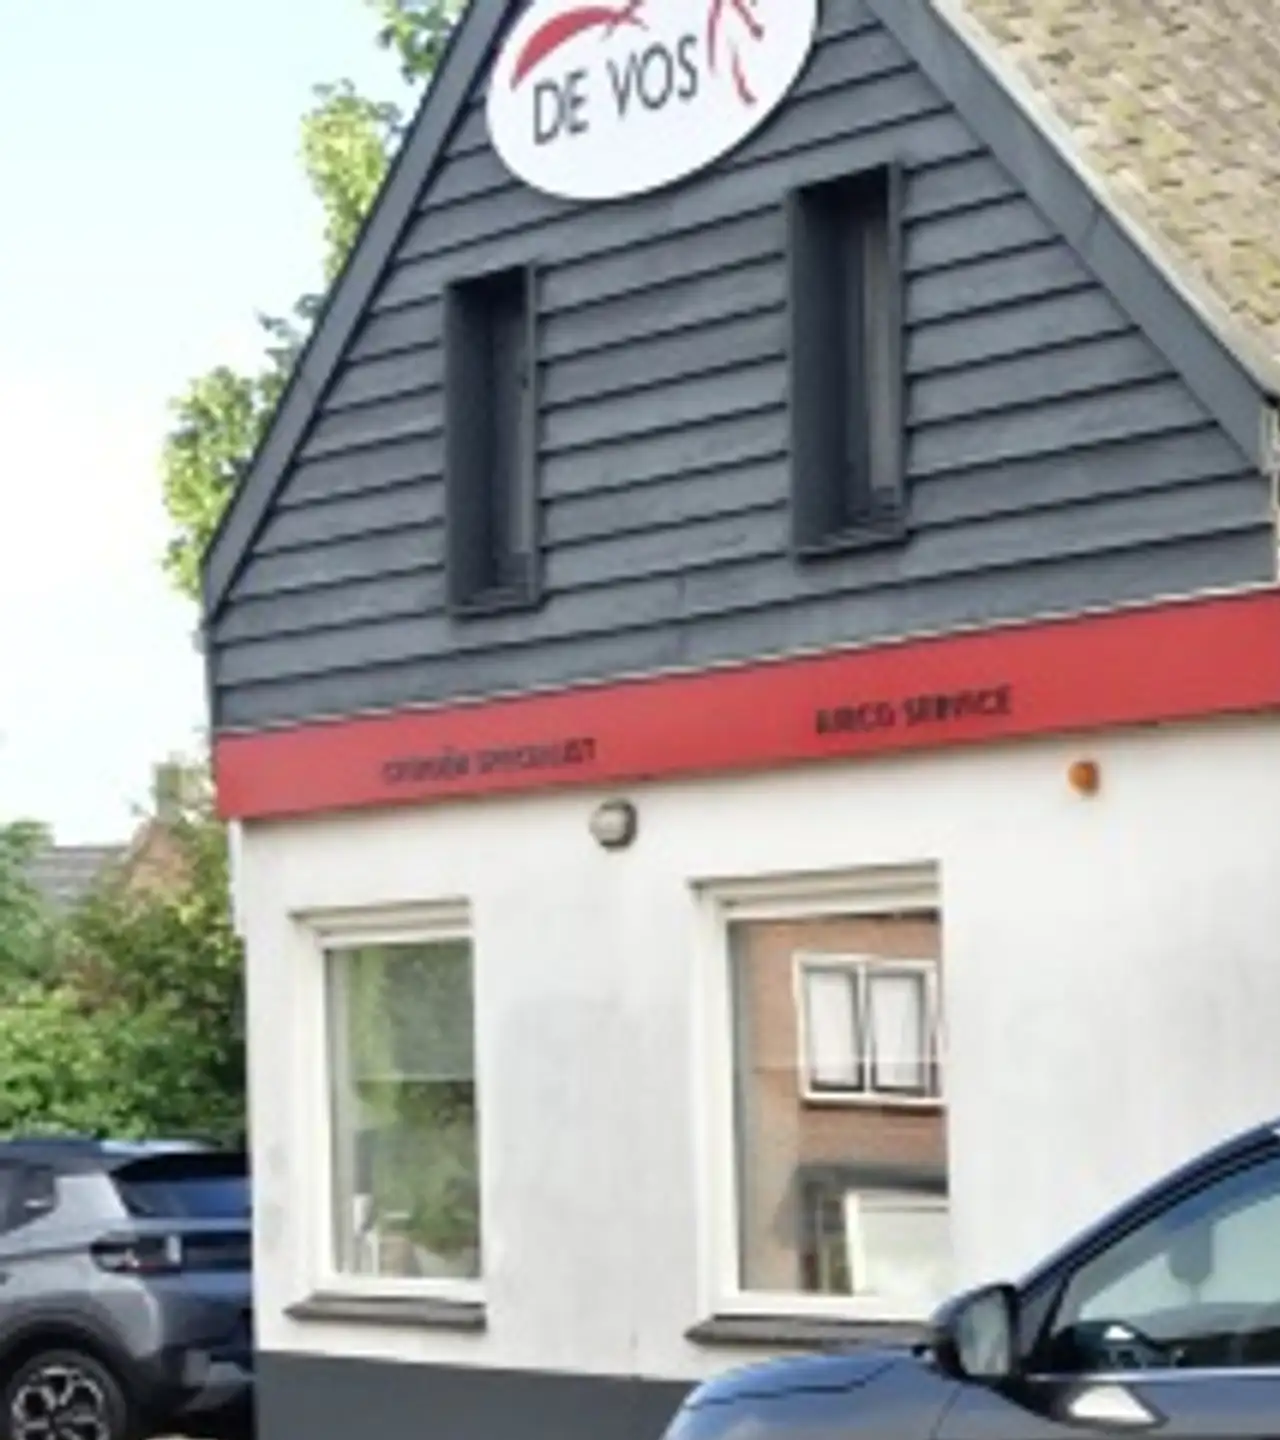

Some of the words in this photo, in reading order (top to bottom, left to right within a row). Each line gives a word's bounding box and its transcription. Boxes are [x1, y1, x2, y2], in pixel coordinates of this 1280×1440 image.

[533, 68, 588, 145] DE
[606, 34, 698, 117] VOS
[816, 701, 896, 735] AIRCO
[903, 682, 1012, 728] SERVICE
